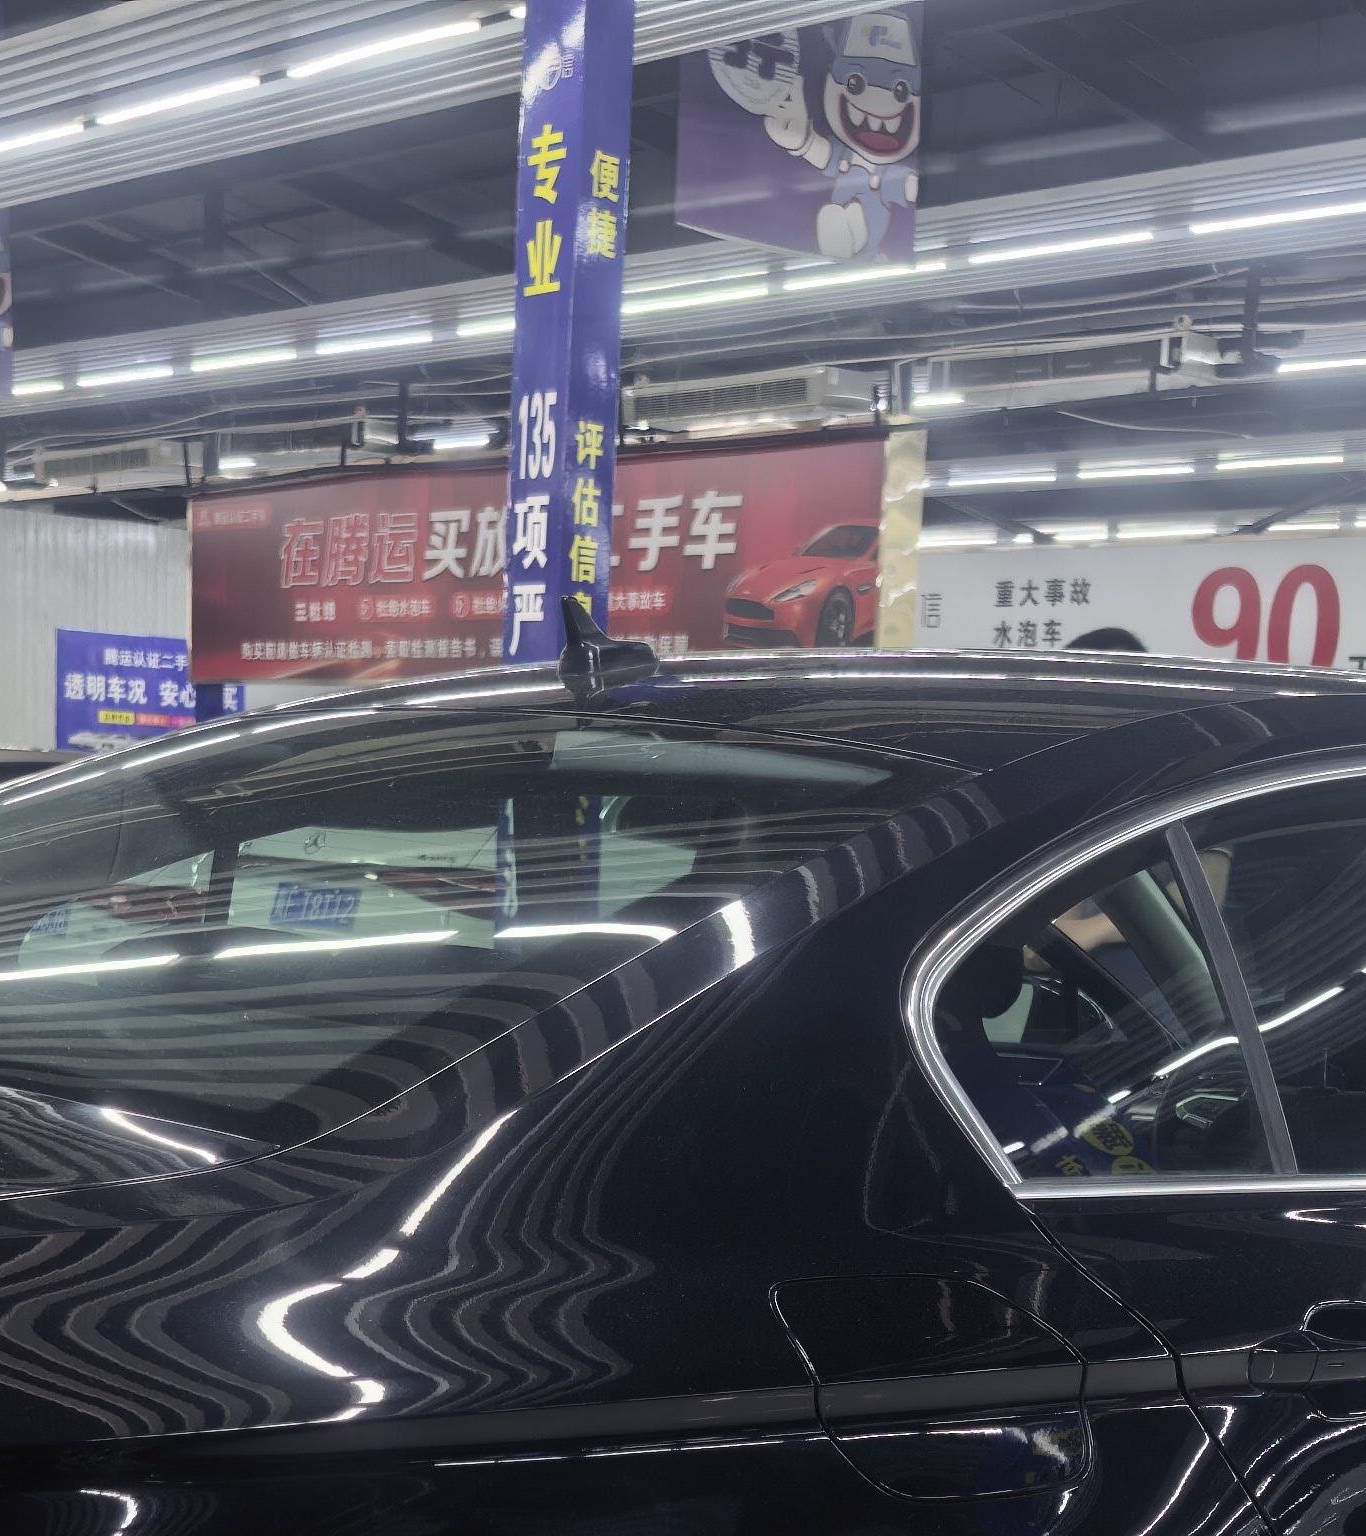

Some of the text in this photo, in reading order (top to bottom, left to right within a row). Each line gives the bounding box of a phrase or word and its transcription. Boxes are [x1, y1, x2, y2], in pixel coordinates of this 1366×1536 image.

[523, 123, 568, 298] 专业
[588, 149, 621, 259] 便捷
[994, 576, 1093, 608] 重大事故
[1191, 563, 1342, 668] 90
[993, 618, 1063, 648] 水泡车
[63, 672, 148, 706] 透明车况
